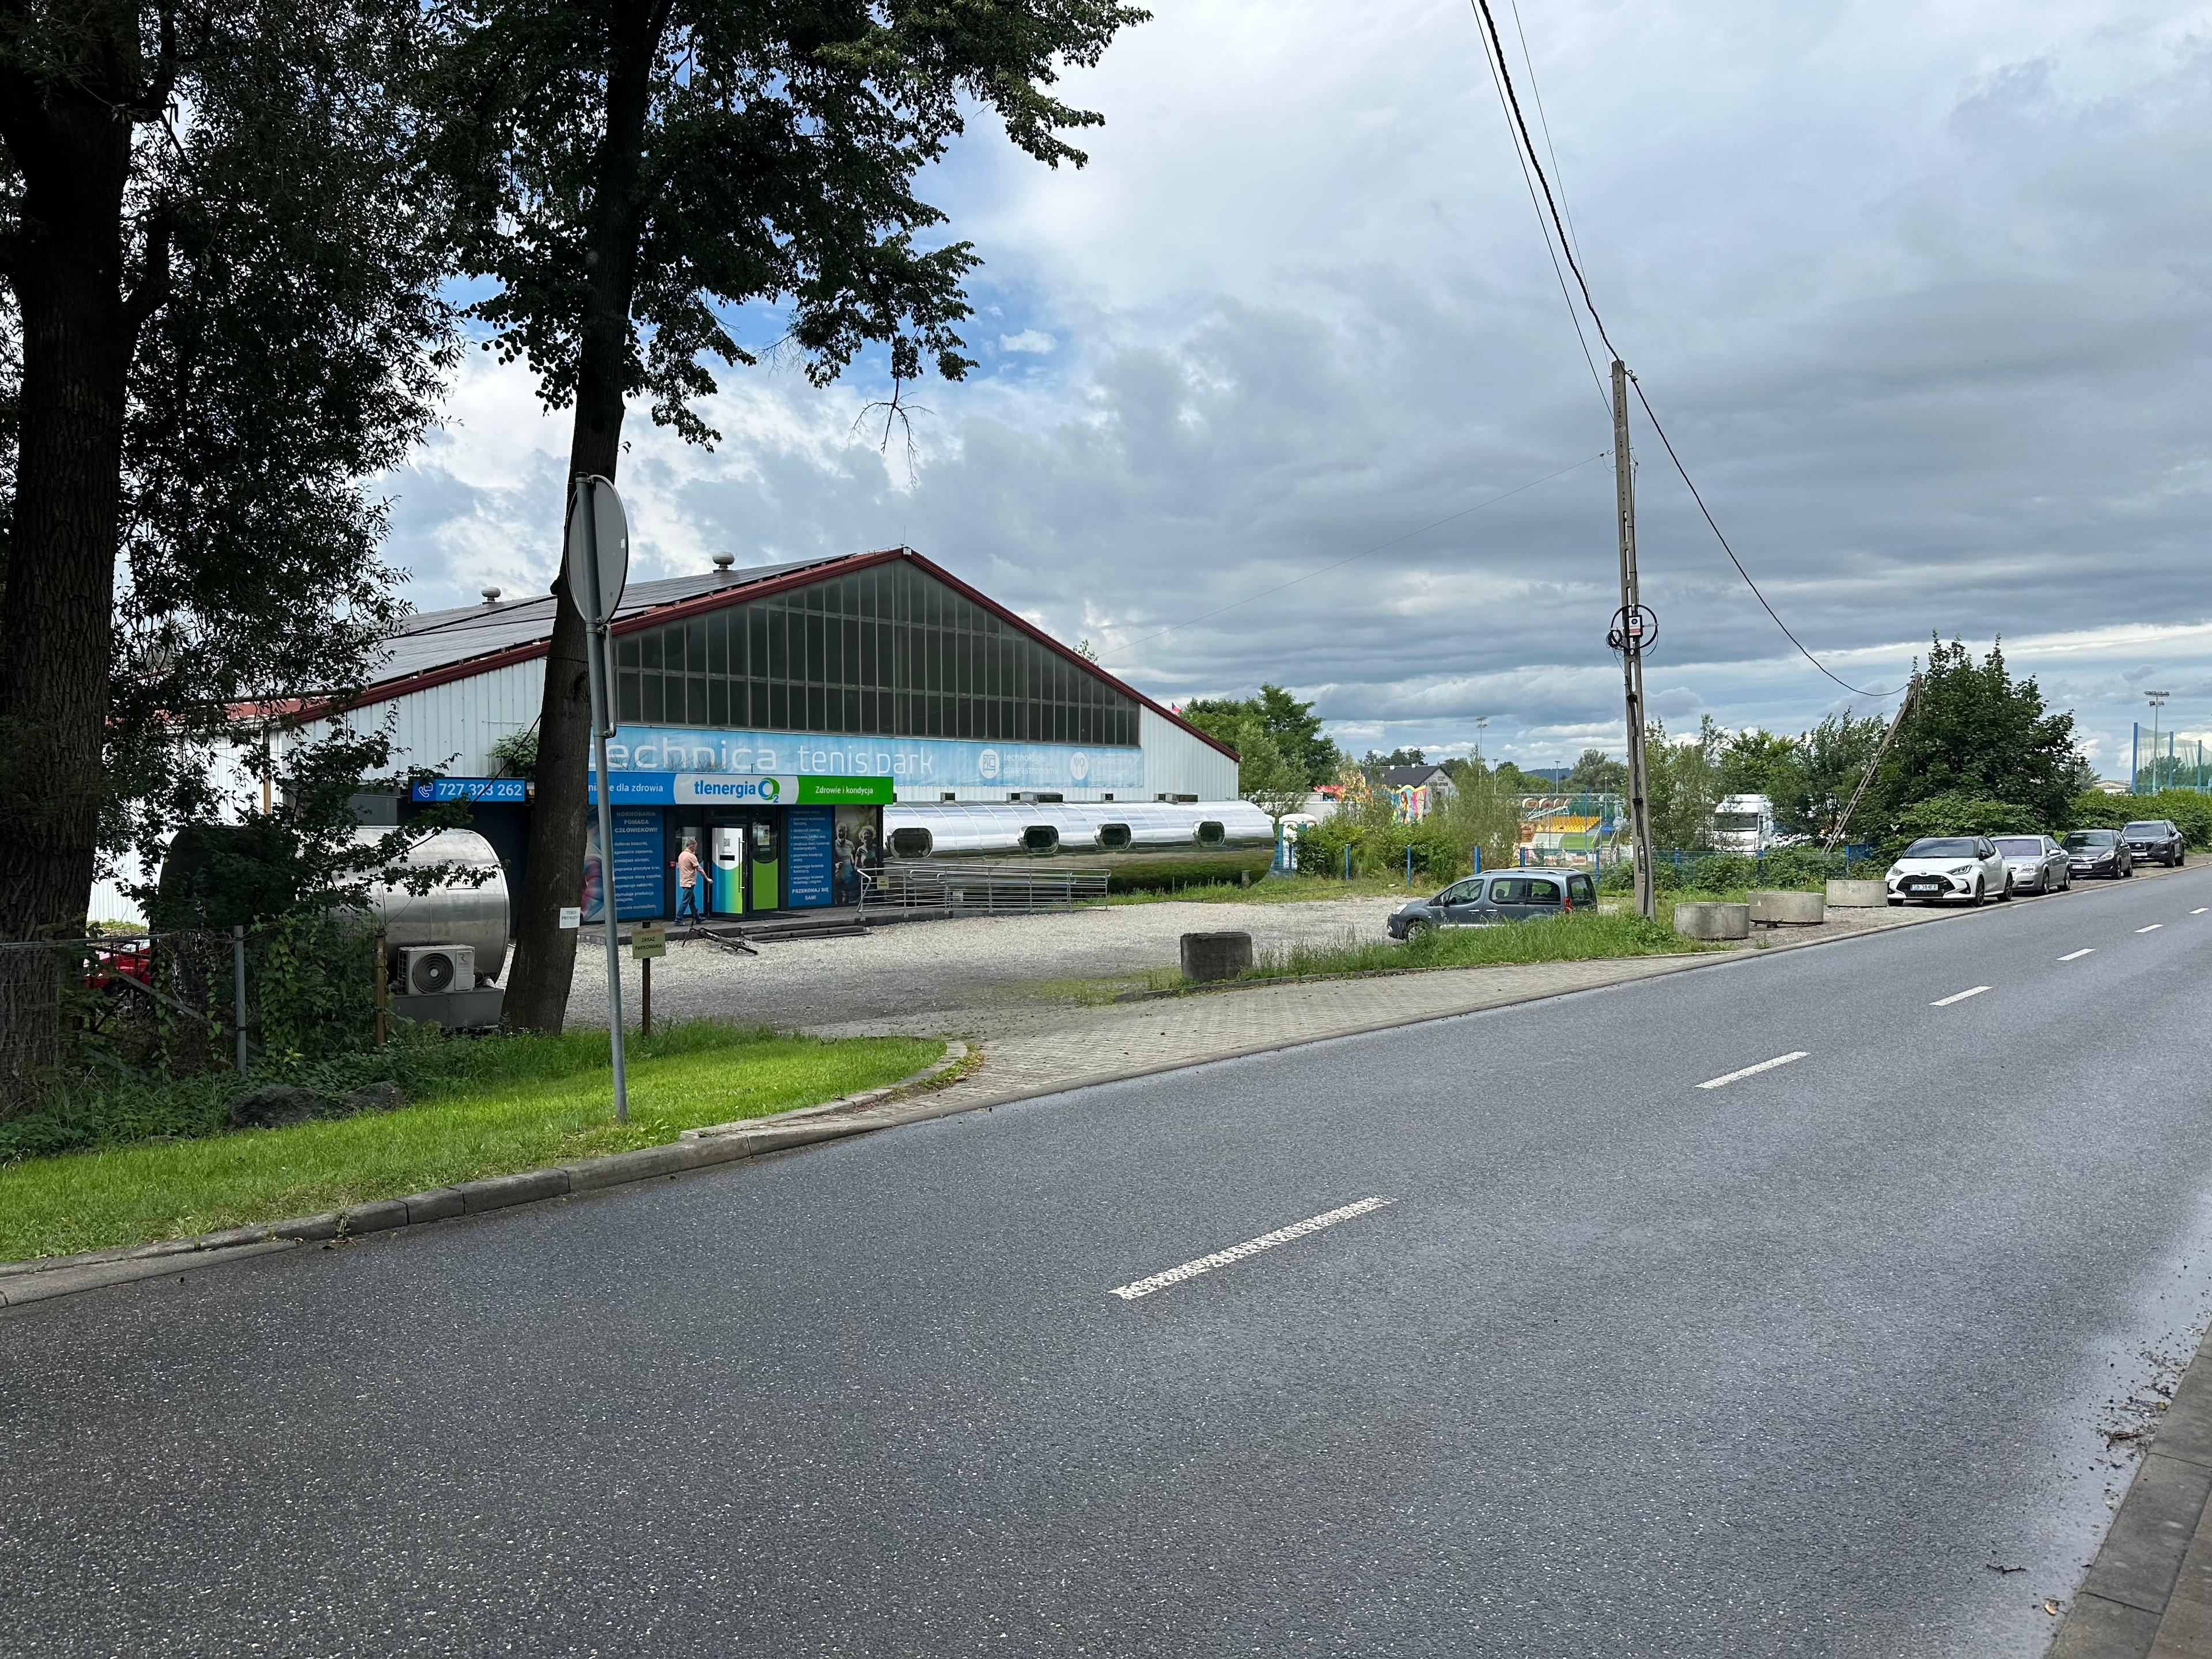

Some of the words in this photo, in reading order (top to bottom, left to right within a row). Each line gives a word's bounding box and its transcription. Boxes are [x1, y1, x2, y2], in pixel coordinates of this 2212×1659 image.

[589, 737, 777, 770] echnica
[798, 745, 868, 773] tenis
[877, 747, 933, 777] park
[438, 783, 465, 796] 727
[468, 783, 494, 796] 323
[497, 783, 522, 796] 262
[616, 783, 629, 792] dla
[631, 783, 663, 792] zdrowia
[694, 780, 756, 798] tlenergia
[815, 786, 842, 794] Zdrowie
[842, 786, 844, 794] i
[846, 786, 873, 796] kondycja
